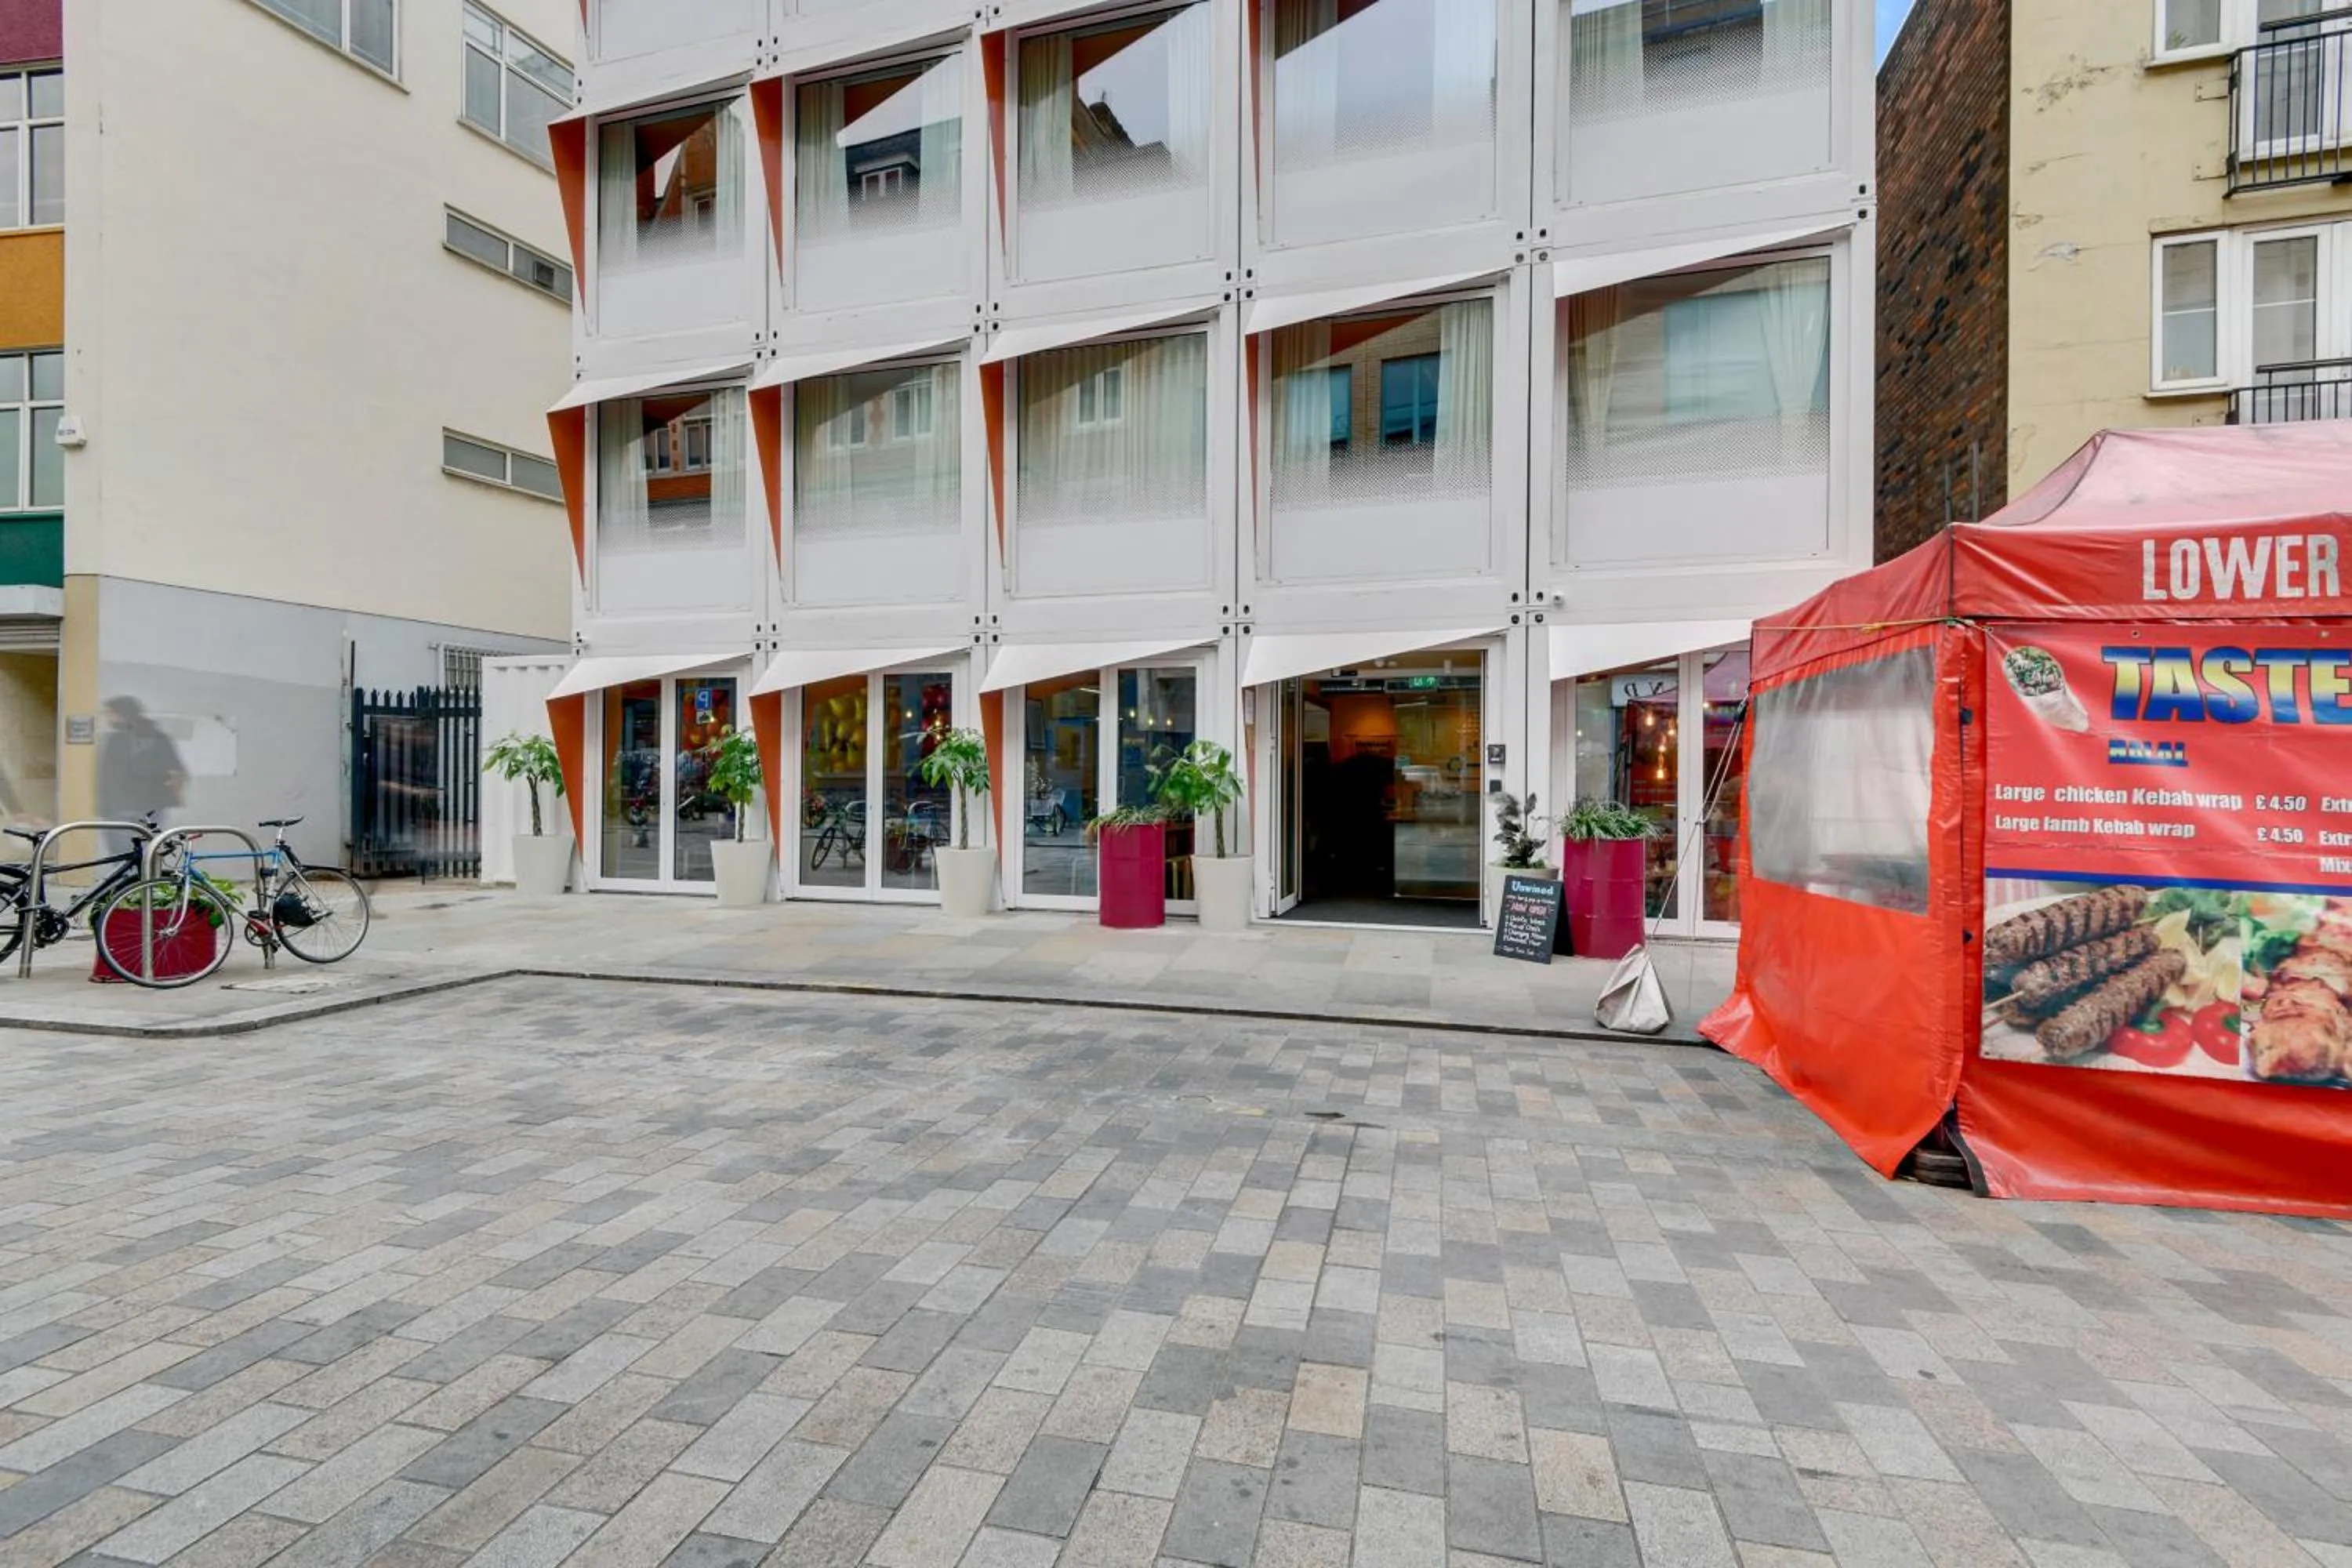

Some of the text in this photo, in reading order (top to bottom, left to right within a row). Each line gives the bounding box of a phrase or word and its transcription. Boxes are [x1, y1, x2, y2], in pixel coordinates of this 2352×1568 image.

[2142, 534, 2340, 600] LOWER
[2101, 645, 2352, 724] TASTE
[1994, 783, 2045, 802] Large
[2054, 786, 2128, 804] chicken
[2132, 787, 2193, 807] Kebab
[2195, 793, 2243, 811] wrap
[2269, 795, 2308, 811] 4.50
[1994, 815, 2039, 832] Large
[2092, 818, 2145, 835] Kebab
[2148, 822, 2195, 838] wrap
[2270, 827, 2304, 843] 4.50
